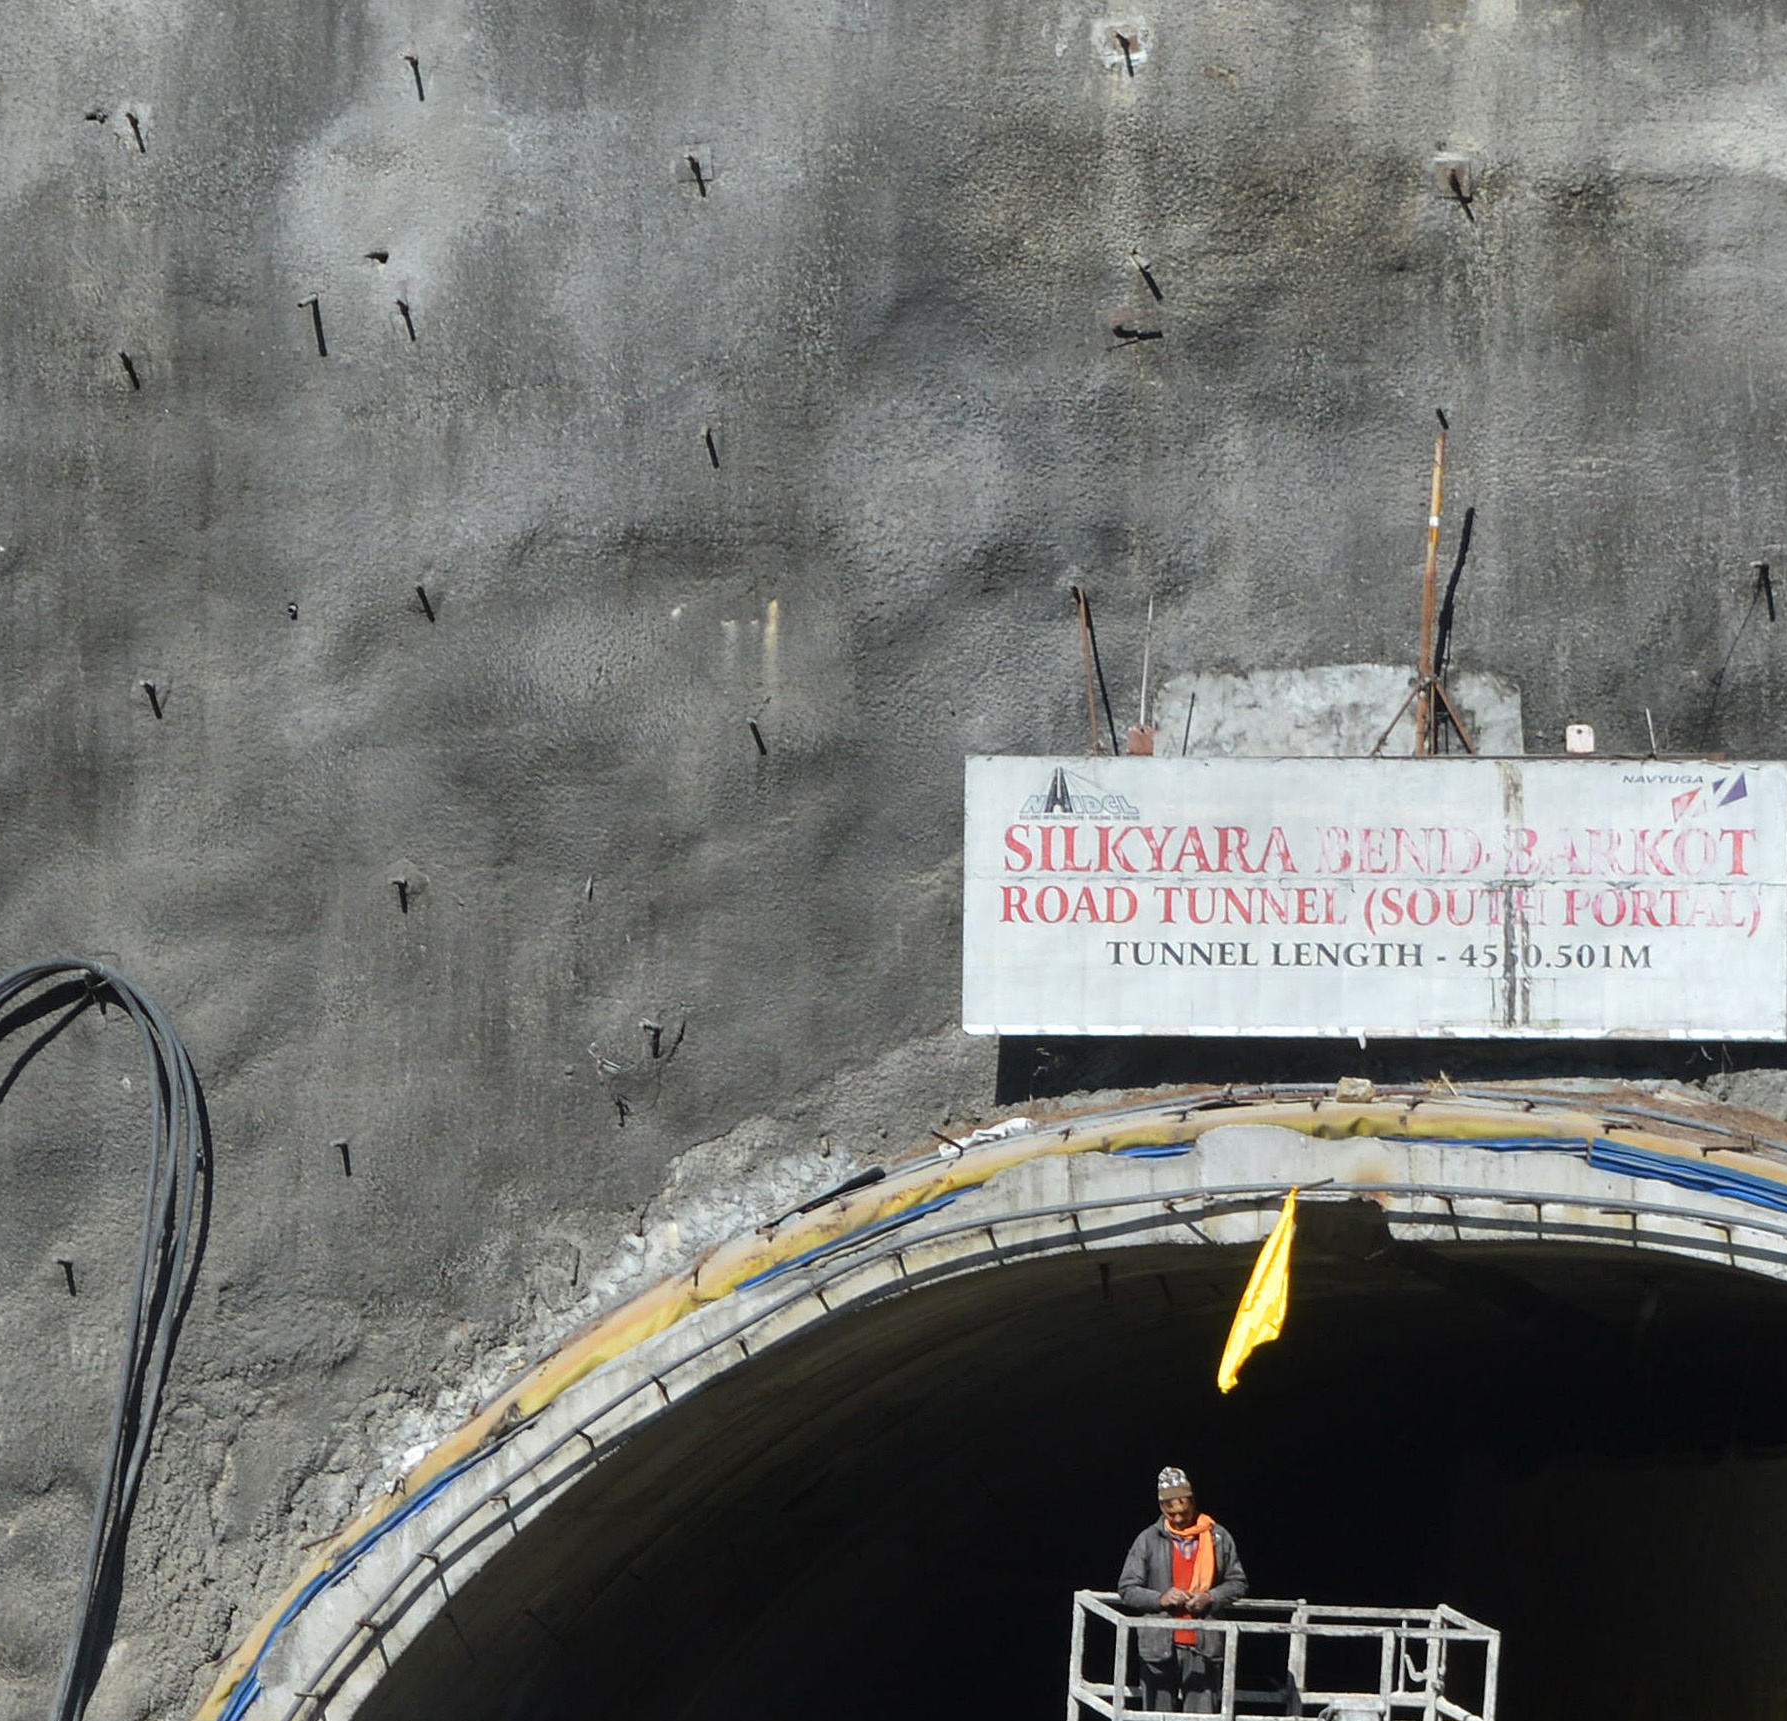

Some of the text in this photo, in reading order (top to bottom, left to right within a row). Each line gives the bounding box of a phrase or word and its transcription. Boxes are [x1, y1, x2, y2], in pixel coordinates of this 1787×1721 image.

[1623, 774, 1704, 784] NAVYUGA
[1003, 824, 1299, 874] SILKYARA
[999, 885, 1762, 938] ROAD TUNNEL (SOUTH PORTAL)
[1106, 941, 1259, 967] TUNNEL
[1271, 941, 1424, 968] LENGTH
